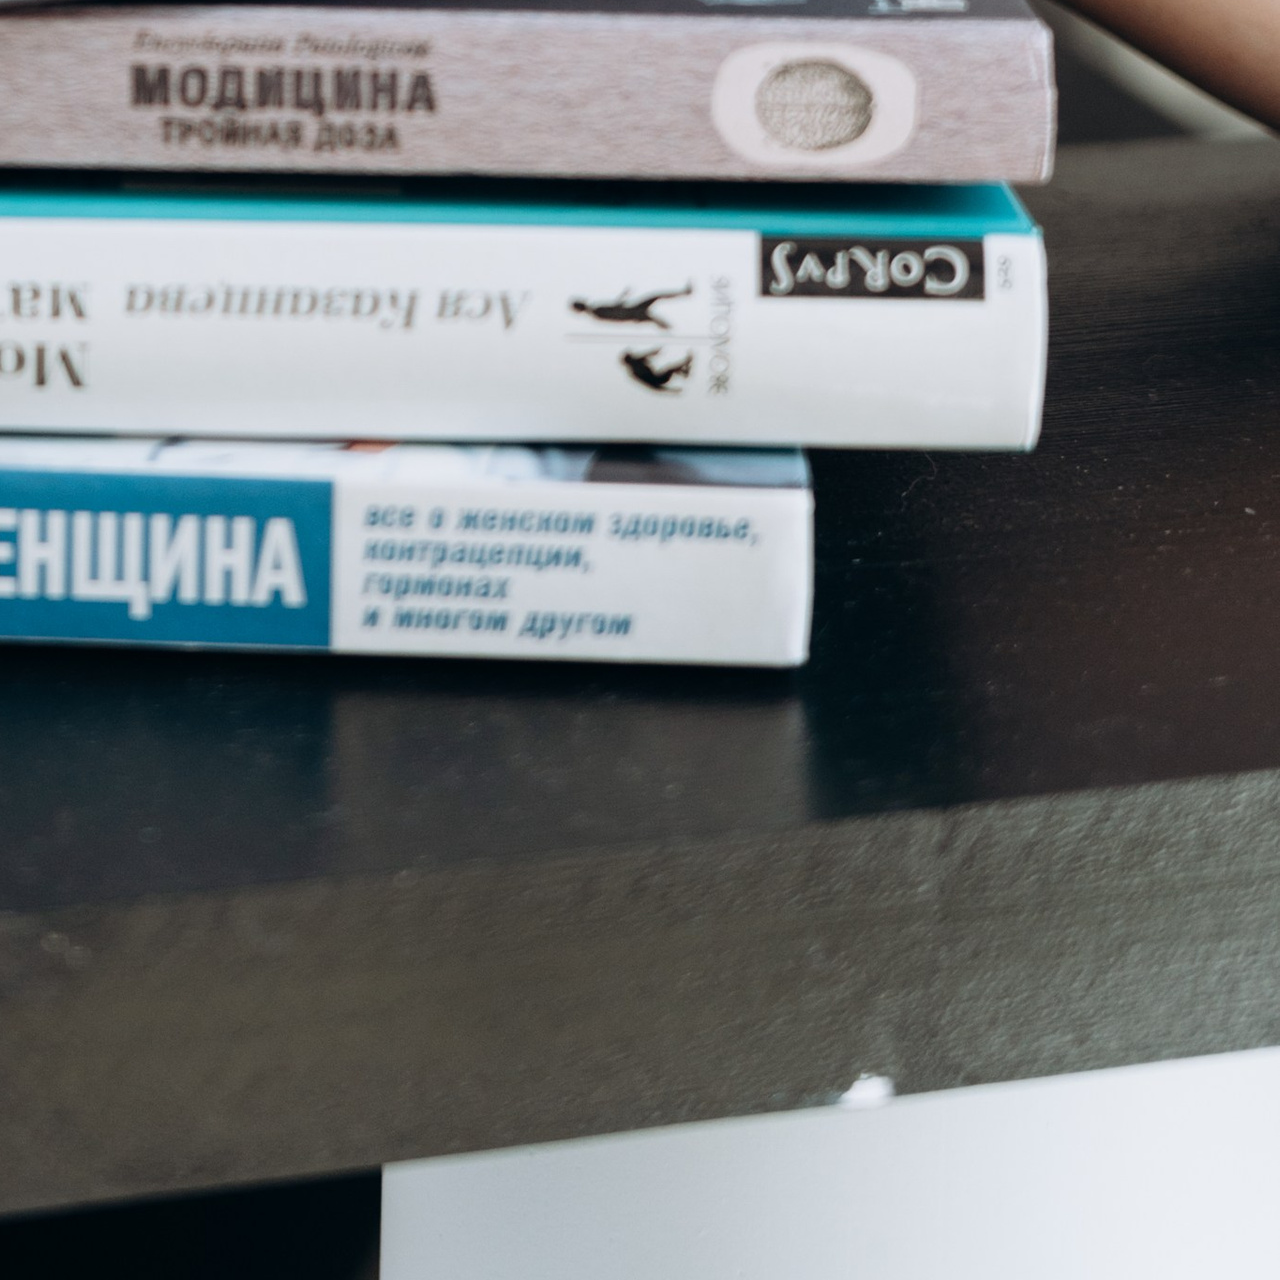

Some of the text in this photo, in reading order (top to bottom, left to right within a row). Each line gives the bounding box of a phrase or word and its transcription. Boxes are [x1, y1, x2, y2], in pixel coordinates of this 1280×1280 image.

[131, 64, 437, 115] МОДИЦИНА
[159, 116, 400, 152] ТРОЙНАЯ ДОЗА
[123, 282, 531, 335] Ася Казанцева
[362, 504, 761, 548] все о женском здоровье,
[361, 536, 594, 575] контрацепции,
[361, 571, 513, 602] гормонах
[361, 606, 636, 642] и многом другом
